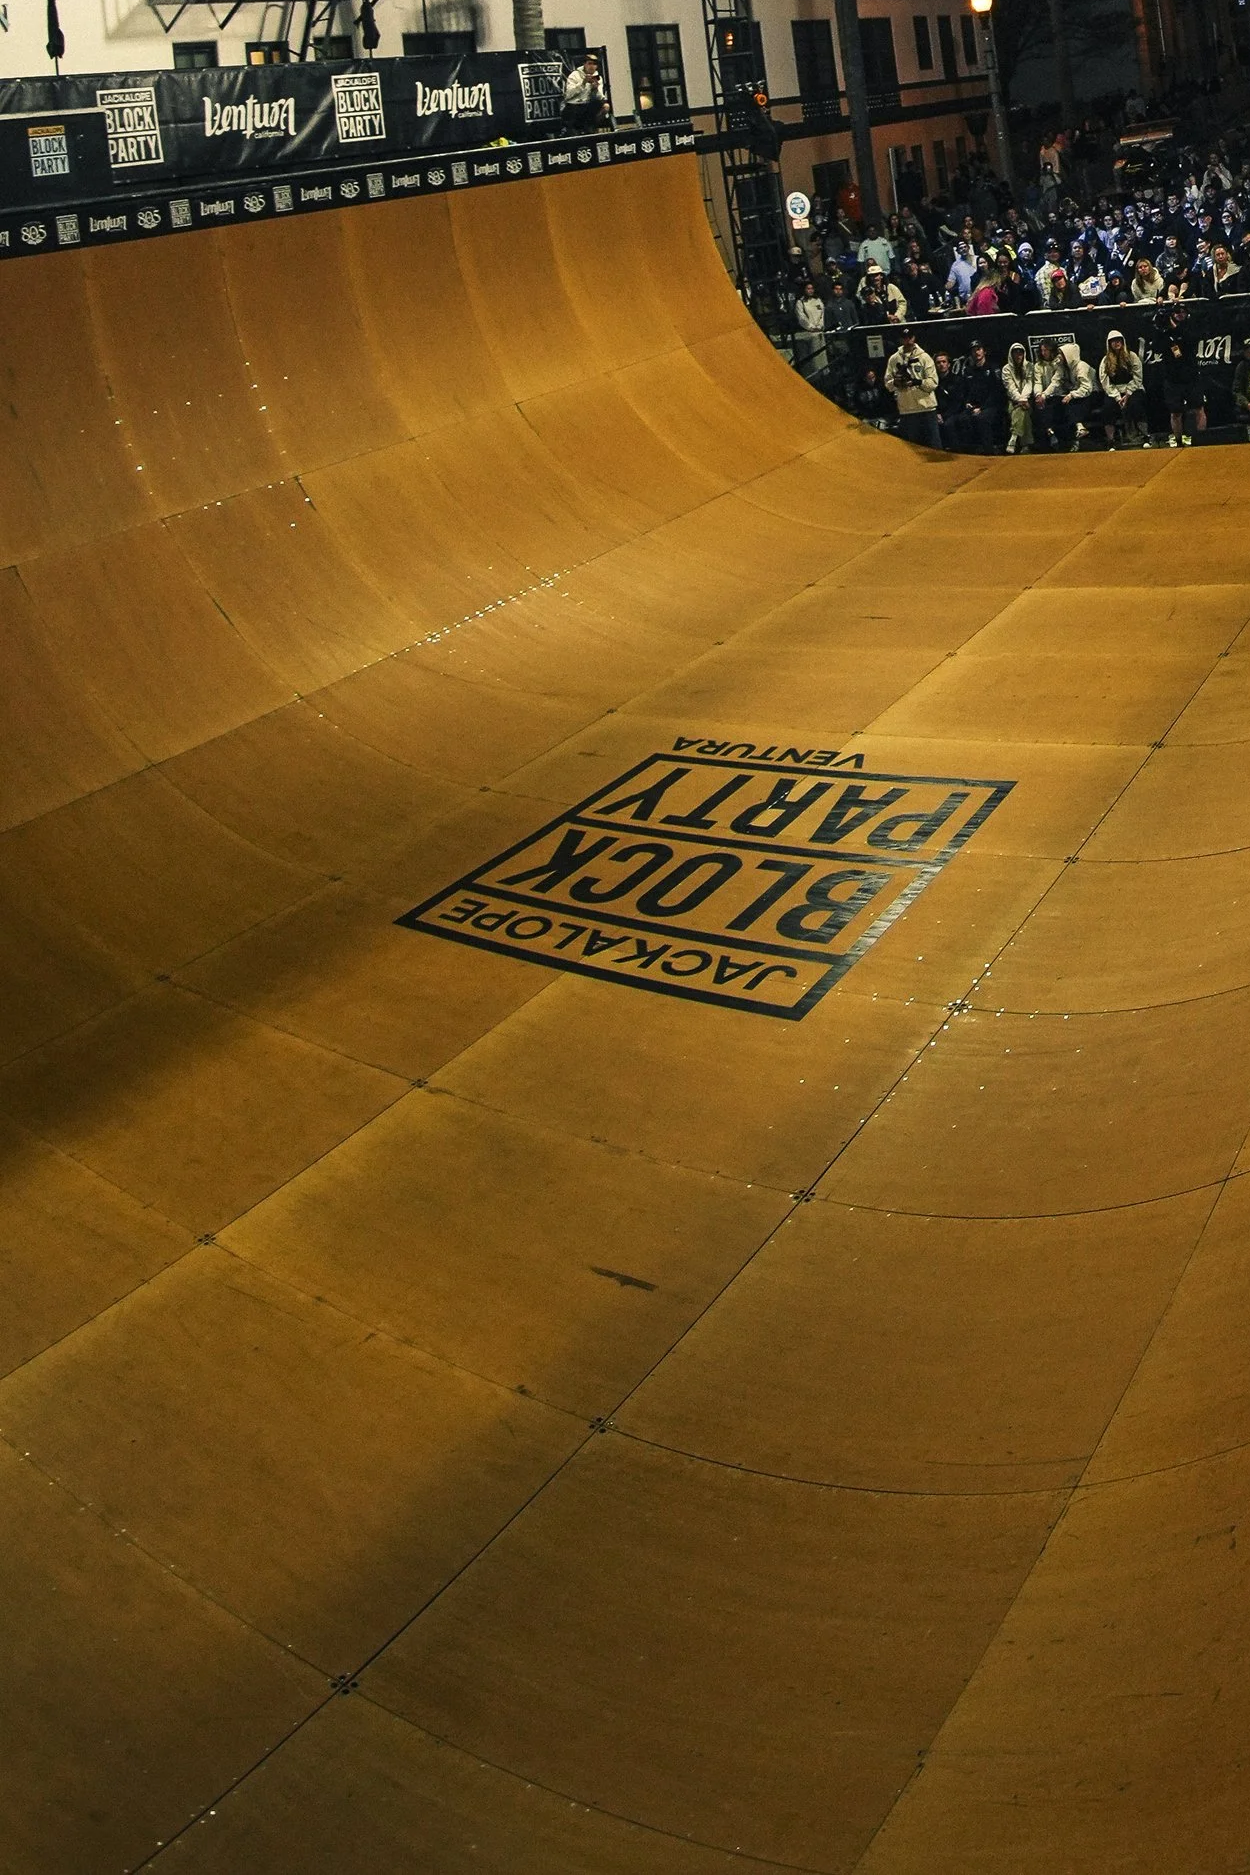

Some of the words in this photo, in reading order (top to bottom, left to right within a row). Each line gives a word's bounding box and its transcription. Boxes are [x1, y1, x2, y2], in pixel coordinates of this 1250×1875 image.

[335, 76, 377, 87] JACKALOPE
[102, 91, 152, 104] JACKALOPE
[337, 89, 380, 113] BLOCK
[526, 99, 557, 119] PART
[105, 106, 155, 133] BLOCK
[341, 114, 382, 138] PARTY
[31, 137, 66, 155] BLOCK
[108, 135, 157, 163] PARTY
[33, 156, 67, 175] PARTY
[137, 209, 161, 225] 805
[21, 225, 47, 242] 805
[673, 736, 865, 769] VENTURA
[595, 767, 967, 853] PARTY
[500, 830, 895, 945] BLOCK
[439, 898, 798, 991] JACKALOPE
